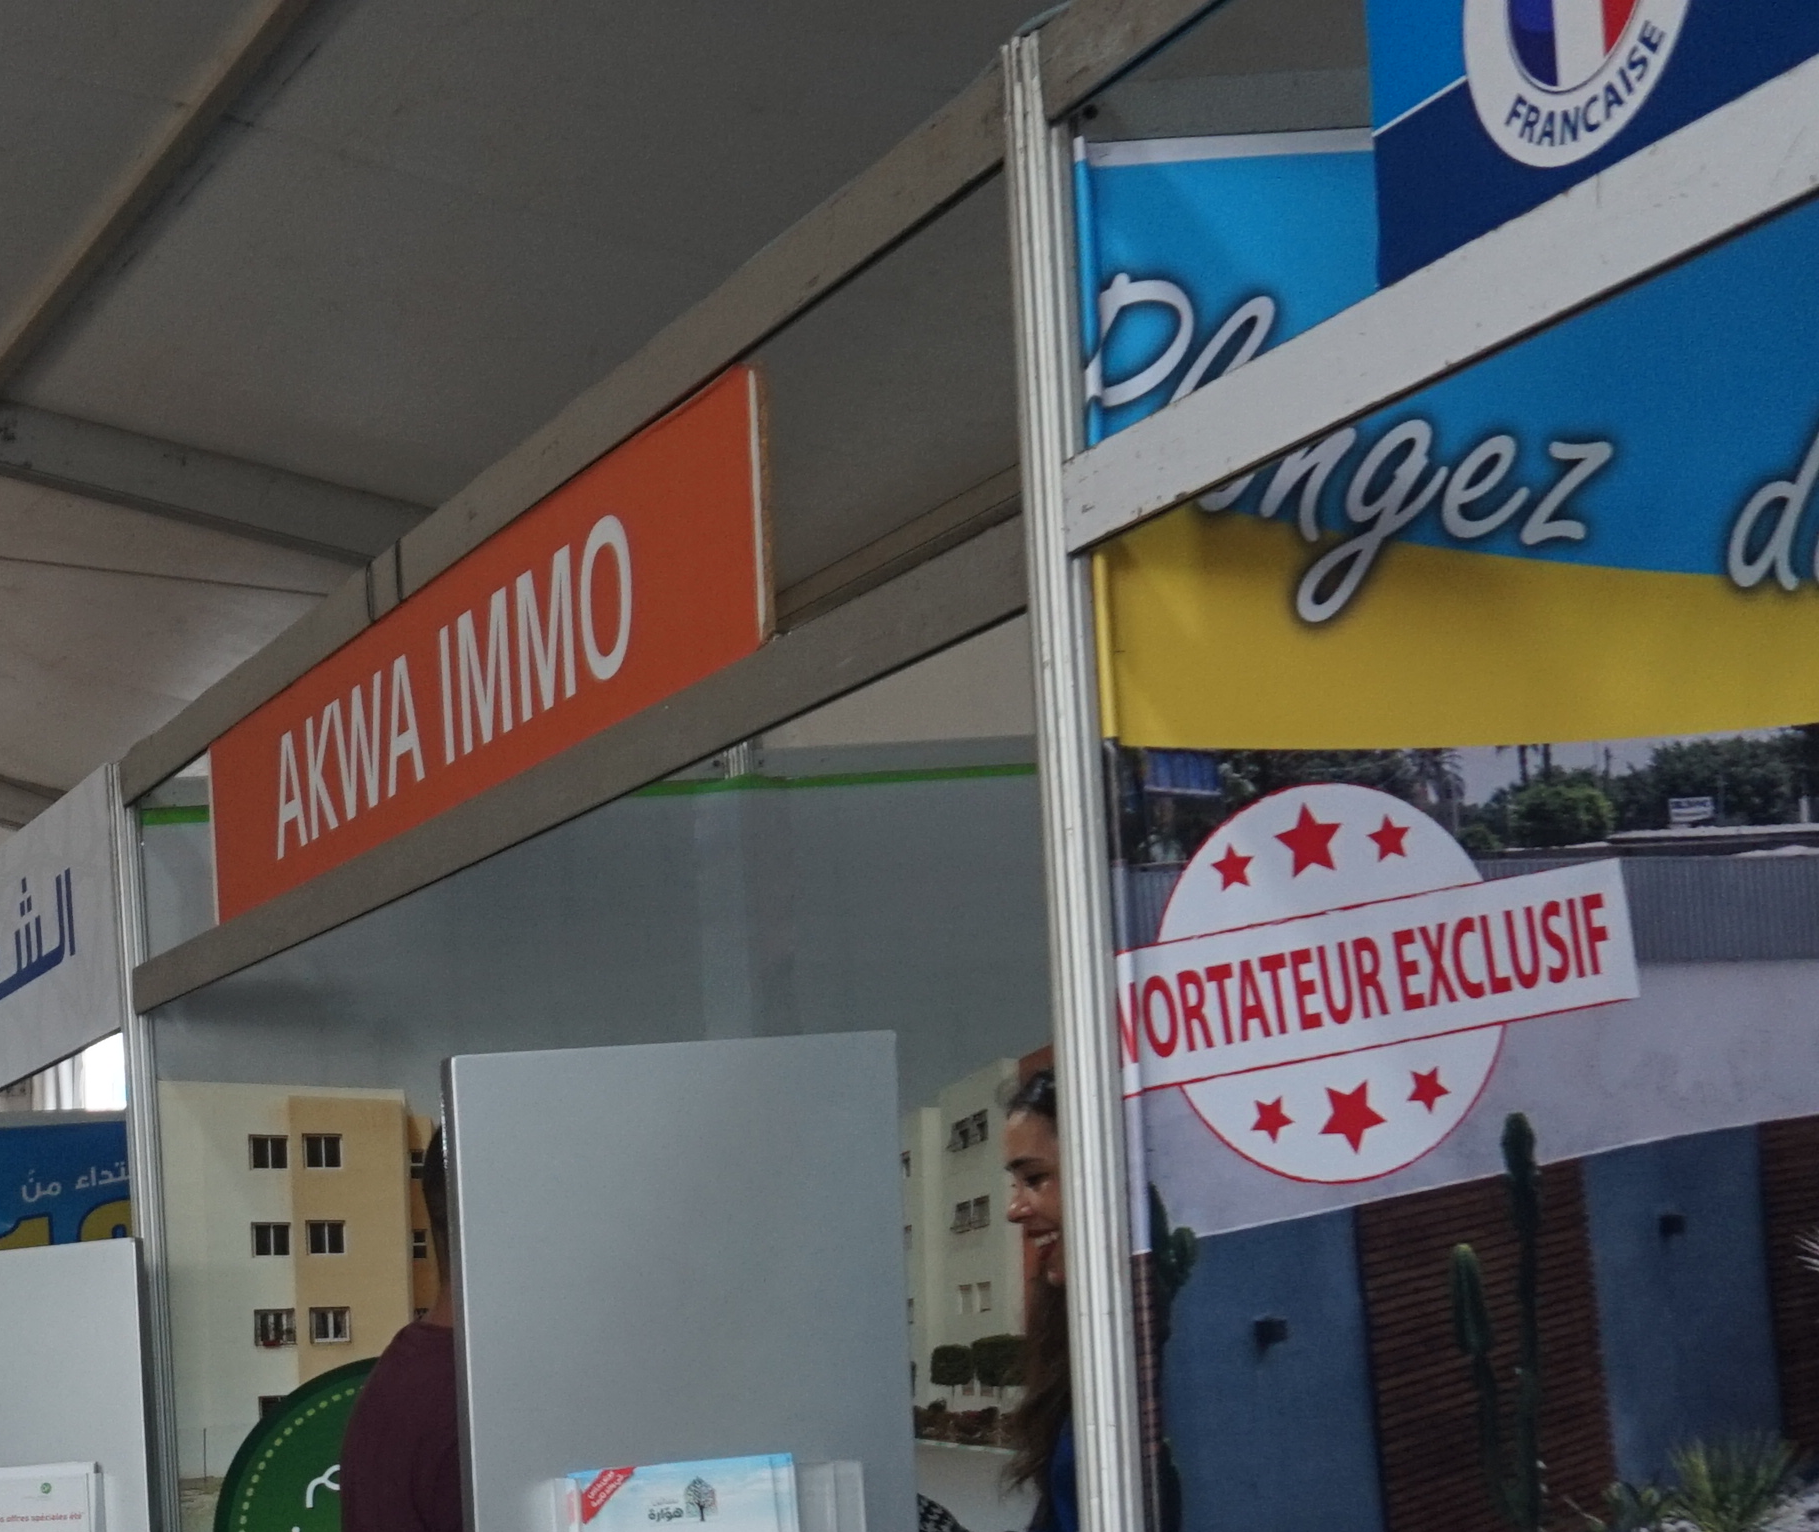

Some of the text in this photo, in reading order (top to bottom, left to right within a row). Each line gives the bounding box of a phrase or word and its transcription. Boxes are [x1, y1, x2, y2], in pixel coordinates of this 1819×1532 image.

[1505, 20, 1667, 146] FRANCAISE
[1085, 273, 1613, 622] Plngez
[277, 514, 633, 860] AKWA IMMO
[1394, 892, 1611, 1010] EXCLUSIF
